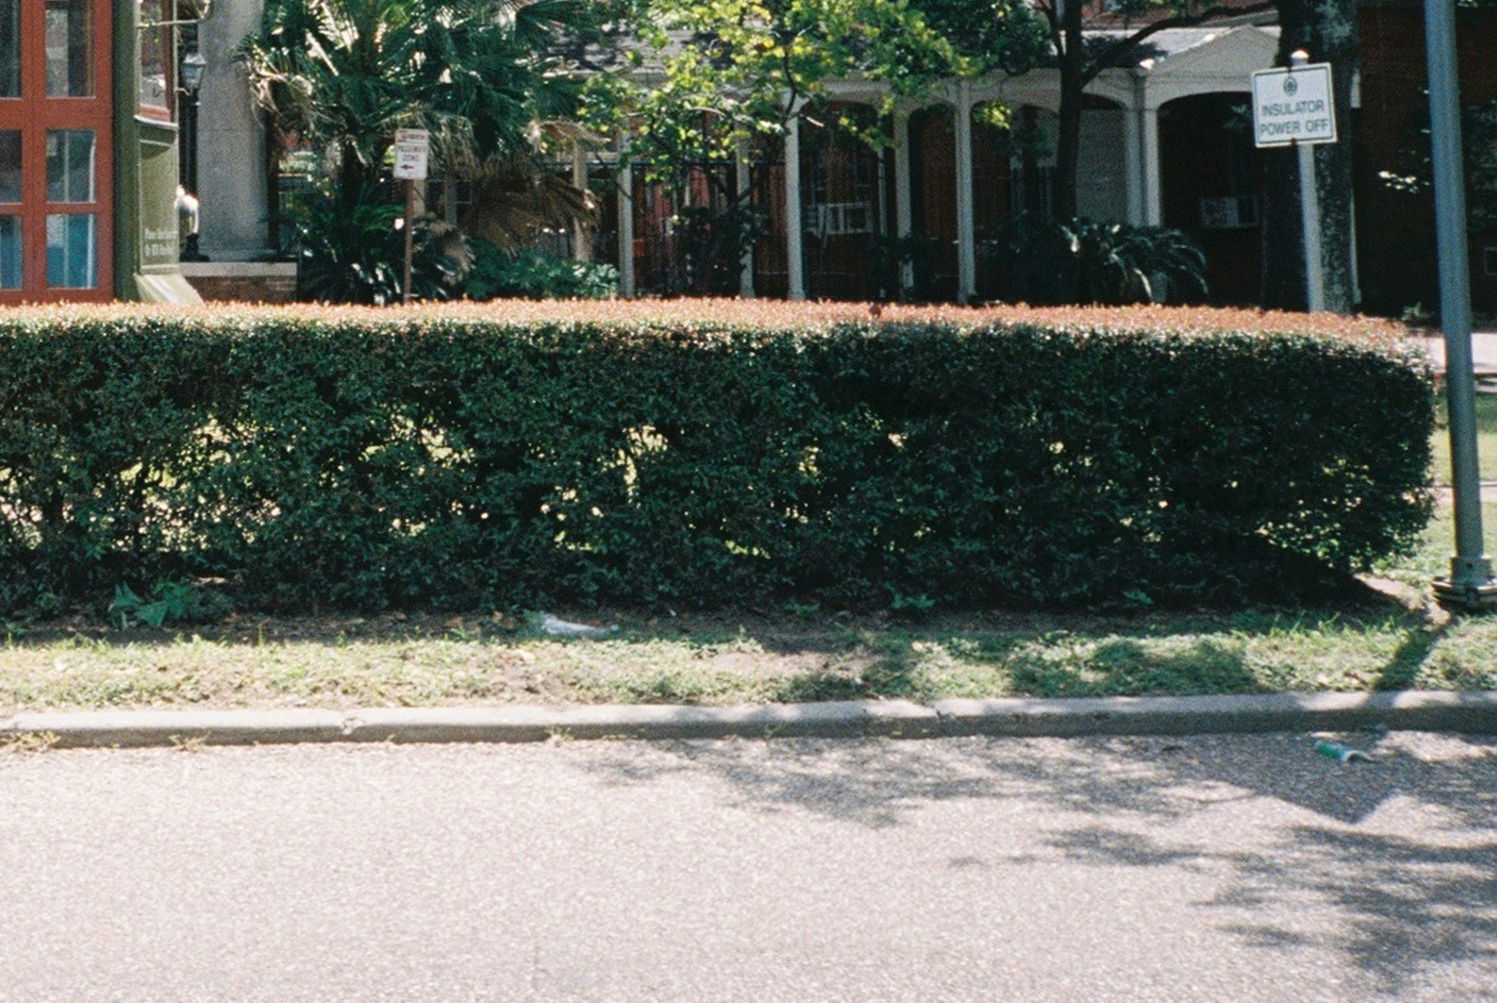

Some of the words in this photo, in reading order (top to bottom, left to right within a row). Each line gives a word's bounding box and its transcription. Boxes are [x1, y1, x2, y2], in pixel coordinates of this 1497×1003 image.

[1262, 100, 1324, 116] INSULATOR
[1261, 121, 1301, 136] POWER
[1306, 118, 1328, 133] OFF
